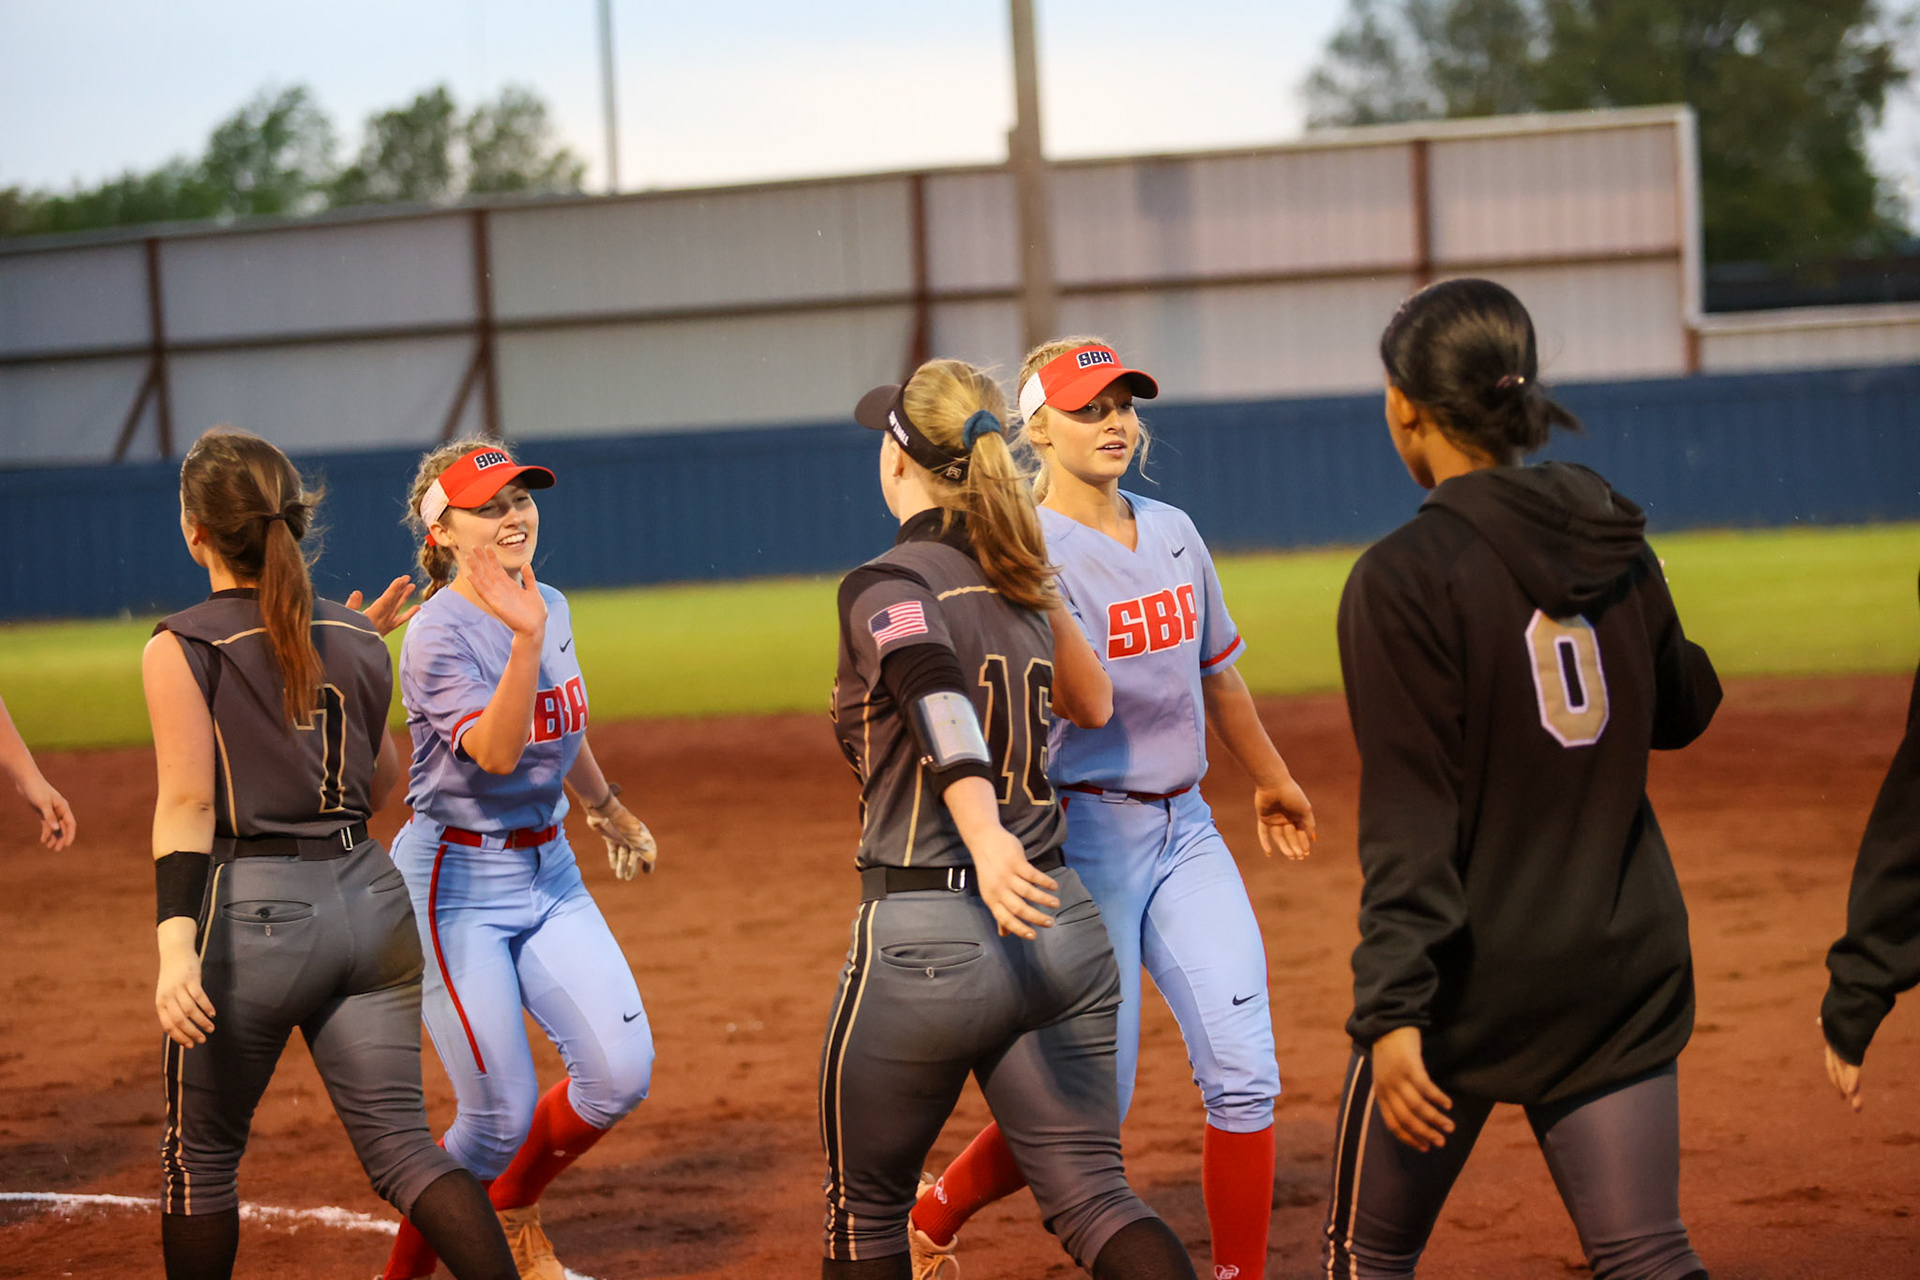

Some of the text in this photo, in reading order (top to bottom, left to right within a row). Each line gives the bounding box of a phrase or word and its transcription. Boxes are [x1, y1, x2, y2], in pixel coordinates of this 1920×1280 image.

[1077, 351, 1114, 368] SBA
[1106, 582, 1199, 661] SBA
[526, 674, 588, 746] BA
[1525, 609, 1609, 748] 0
[978, 654, 1055, 806] 16
